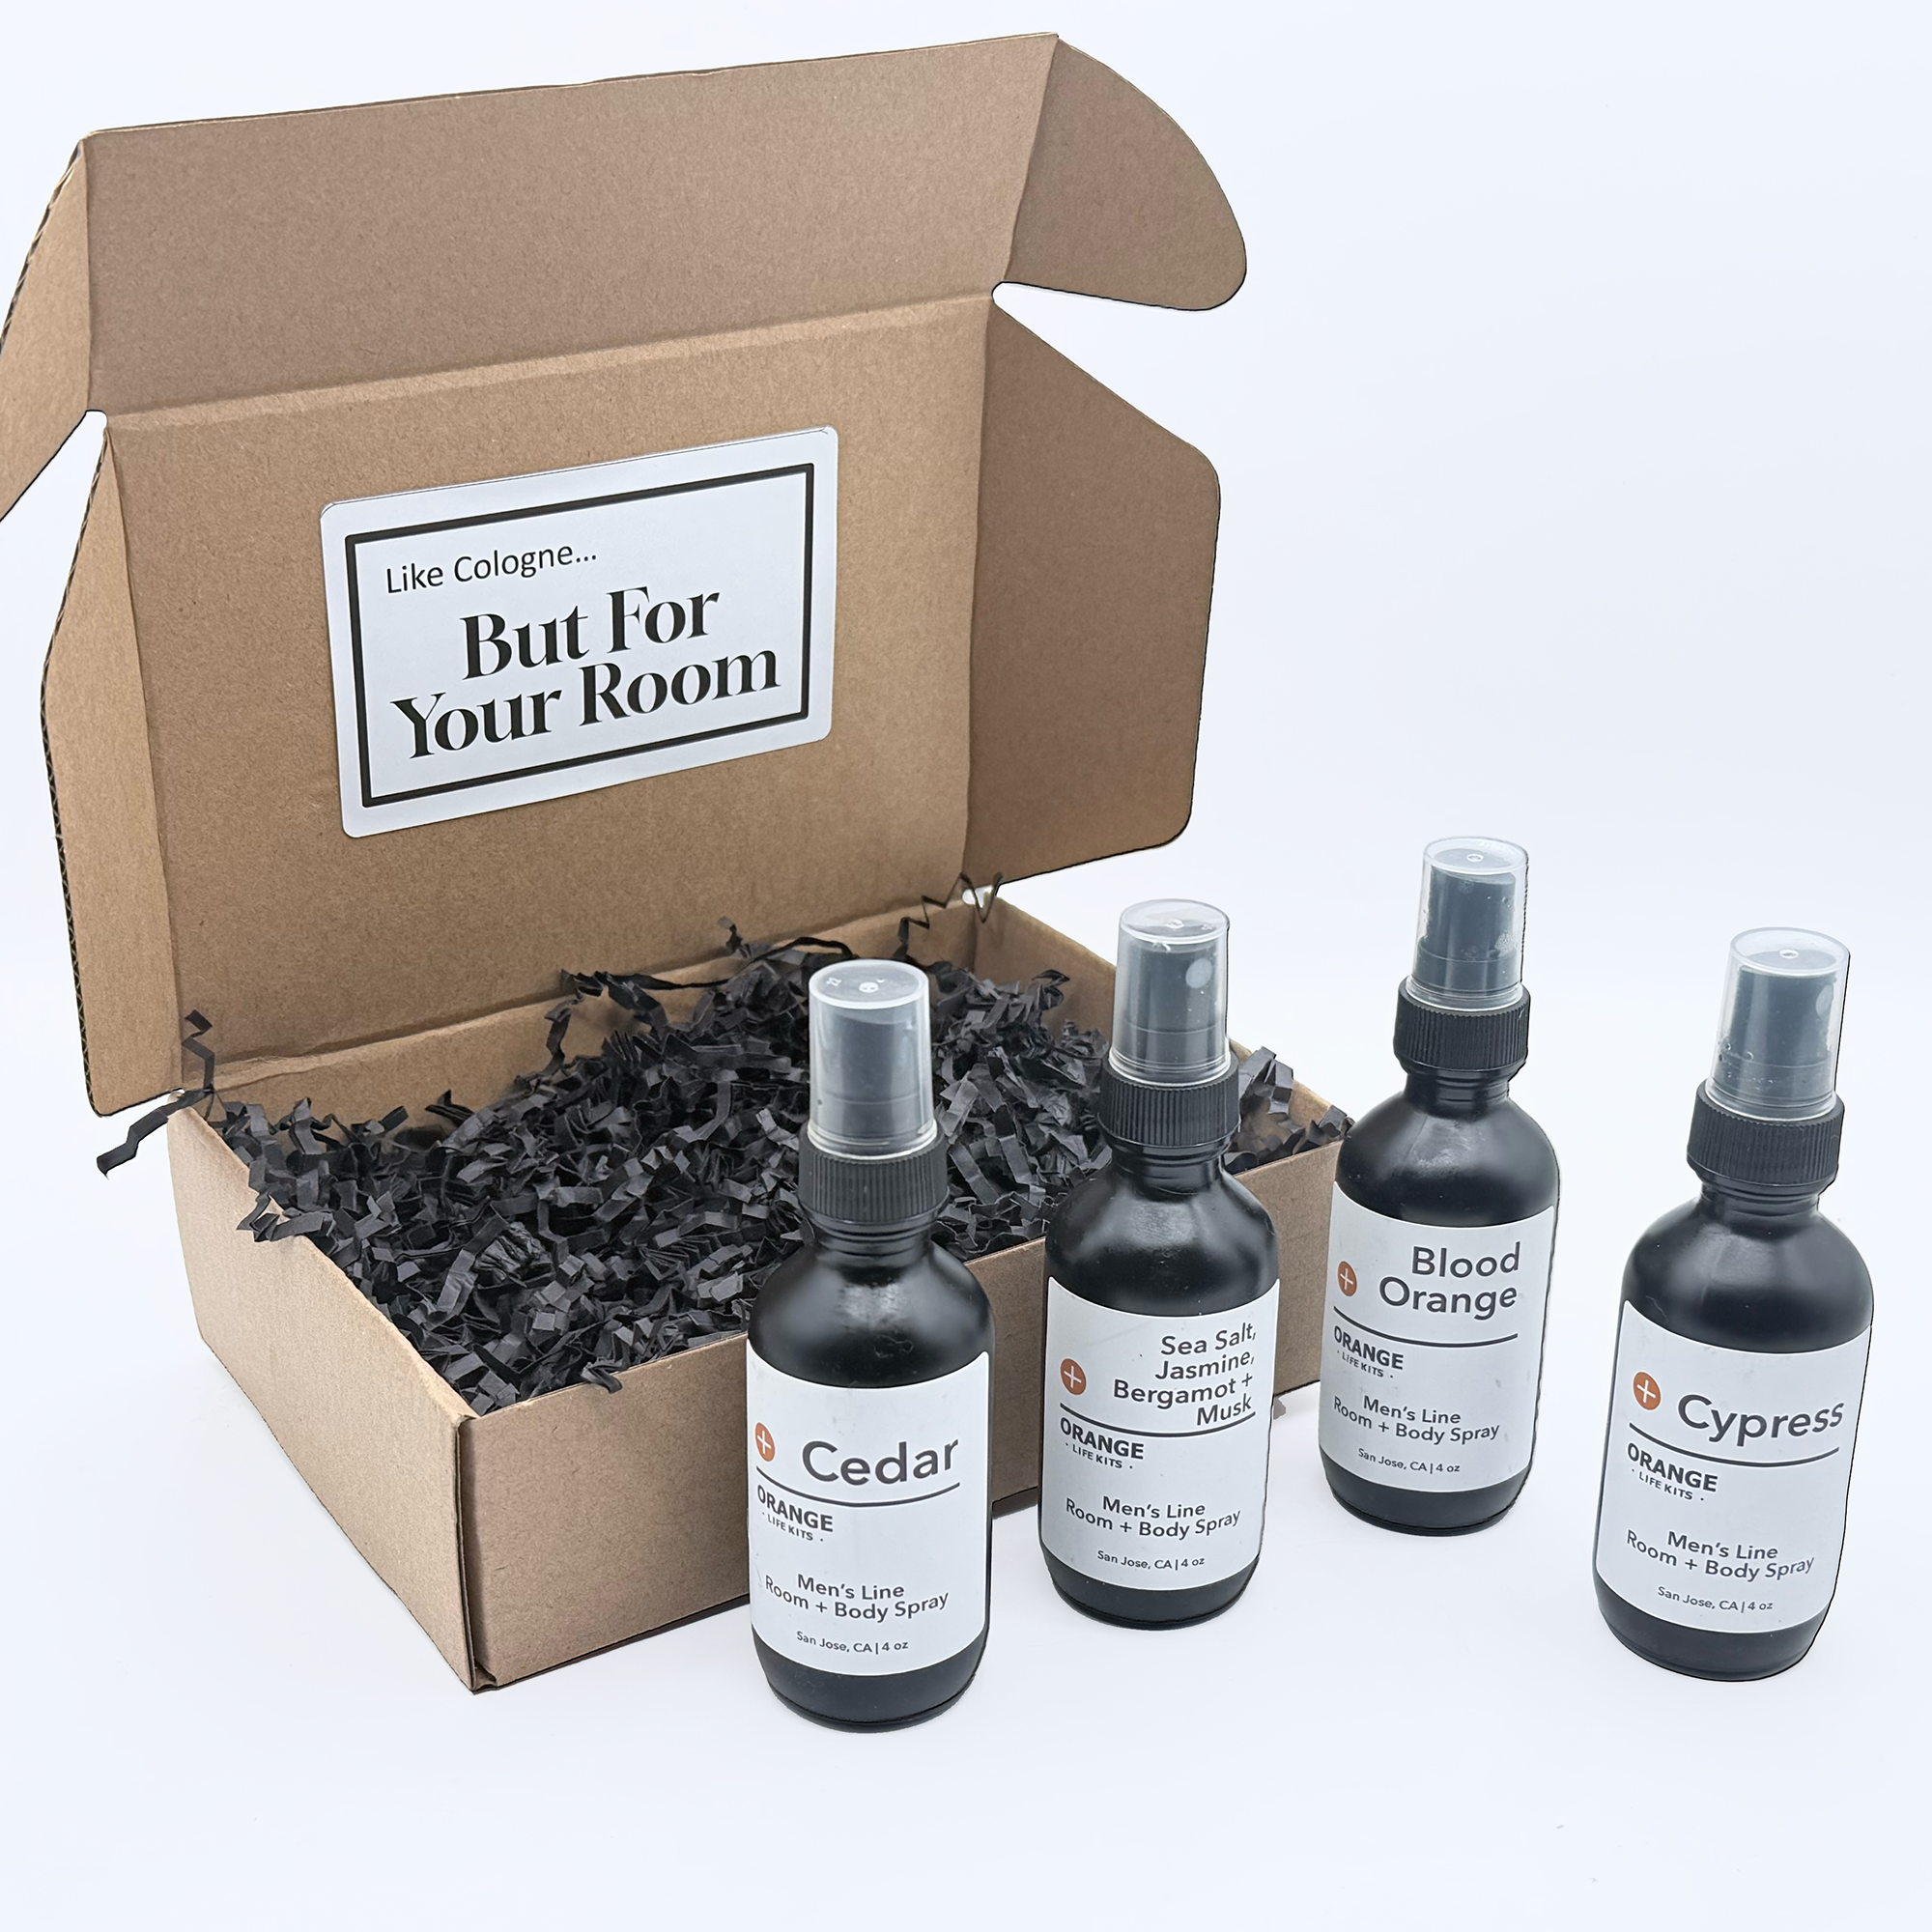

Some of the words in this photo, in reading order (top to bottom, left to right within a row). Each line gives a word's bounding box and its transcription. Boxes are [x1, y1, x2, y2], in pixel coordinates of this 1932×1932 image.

[386, 562, 443, 594] Like
[459, 605, 590, 681] But
[606, 585, 721, 654] For
[389, 689, 562, 759] Your
[579, 649, 781, 727] Room
[1411, 1240, 1520, 1279] Blood
[1378, 1276, 1518, 1321] Orange
[1160, 1335, 1208, 1355] Sea
[1214, 1321, 1257, 1350] Salt,
[1333, 1325, 1404, 1370] ORANGE
[1154, 1350, 1255, 1380] Jasmine,
[1113, 1378, 1236, 1410] Bergamot
[1196, 1392, 1252, 1427] Musk
[1363, 1395, 1416, 1422] Men's
[1421, 1408, 1462, 1424] Line
[1061, 1417, 1144, 1460] ORANGE
[1333, 1395, 1373, 1430] Room
[1395, 1422, 1446, 1446] Body
[1449, 1424, 1500, 1446] Spray
[1677, 1394, 1845, 1448] Cypress
[802, 1438, 959, 1487] Cedar
[1357, 1447, 1377, 1463] San
[1378, 1456, 1407, 1470] Jose,
[1446, 1464, 1461, 1473] oz
[1627, 1442, 1719, 1492] ORANGE
[756, 1484, 834, 1532] ORANGE
[1065, 1497, 1113, 1530] Room
[1139, 1520, 1190, 1541] Body
[1194, 1510, 1241, 1537] Spray
[1102, 1495, 1160, 1519] Men's
[1166, 1503, 1206, 1519] Line
[1096, 1549, 1119, 1564] San
[1120, 1556, 1151, 1570] Jose,
[1191, 1557, 1206, 1567] oz
[1627, 1529, 1677, 1567] Room
[1704, 1559, 1761, 1583] Body
[1764, 1557, 1815, 1581] Spray
[1667, 1530, 1730, 1558] Men's
[1736, 1544, 1778, 1560] Line
[765, 1575, 810, 1610] Room
[835, 1601, 889, 1624] Body
[895, 1592, 949, 1620] Spray
[797, 1573, 855, 1600] Men's
[862, 1584, 905, 1601] Line
[1657, 1585, 1680, 1602] San
[1682, 1594, 1716, 1610] Jose,
[1758, 1603, 1774, 1611] oz
[796, 1631, 817, 1646] San
[819, 1637, 850, 1653] Jose,
[894, 1641, 909, 1651] oz
